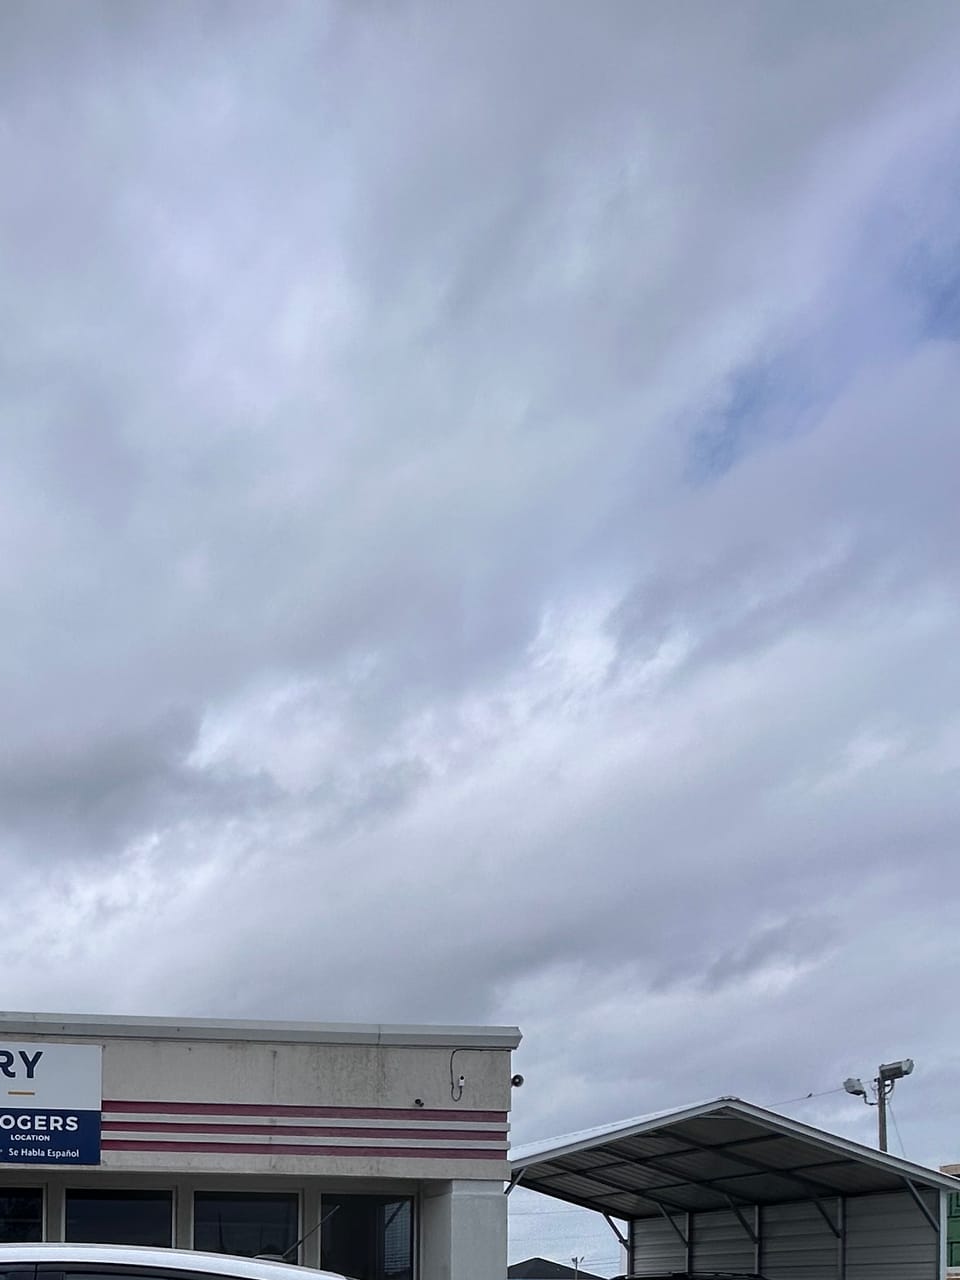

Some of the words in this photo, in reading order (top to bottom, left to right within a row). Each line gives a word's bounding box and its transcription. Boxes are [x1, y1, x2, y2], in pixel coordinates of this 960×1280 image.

[10, 1134, 51, 1142] LOCATION
[8, 1147, 19, 1156] Se
[20, 1148, 45, 1157] Habla
[47, 1148, 80, 1158] Español
